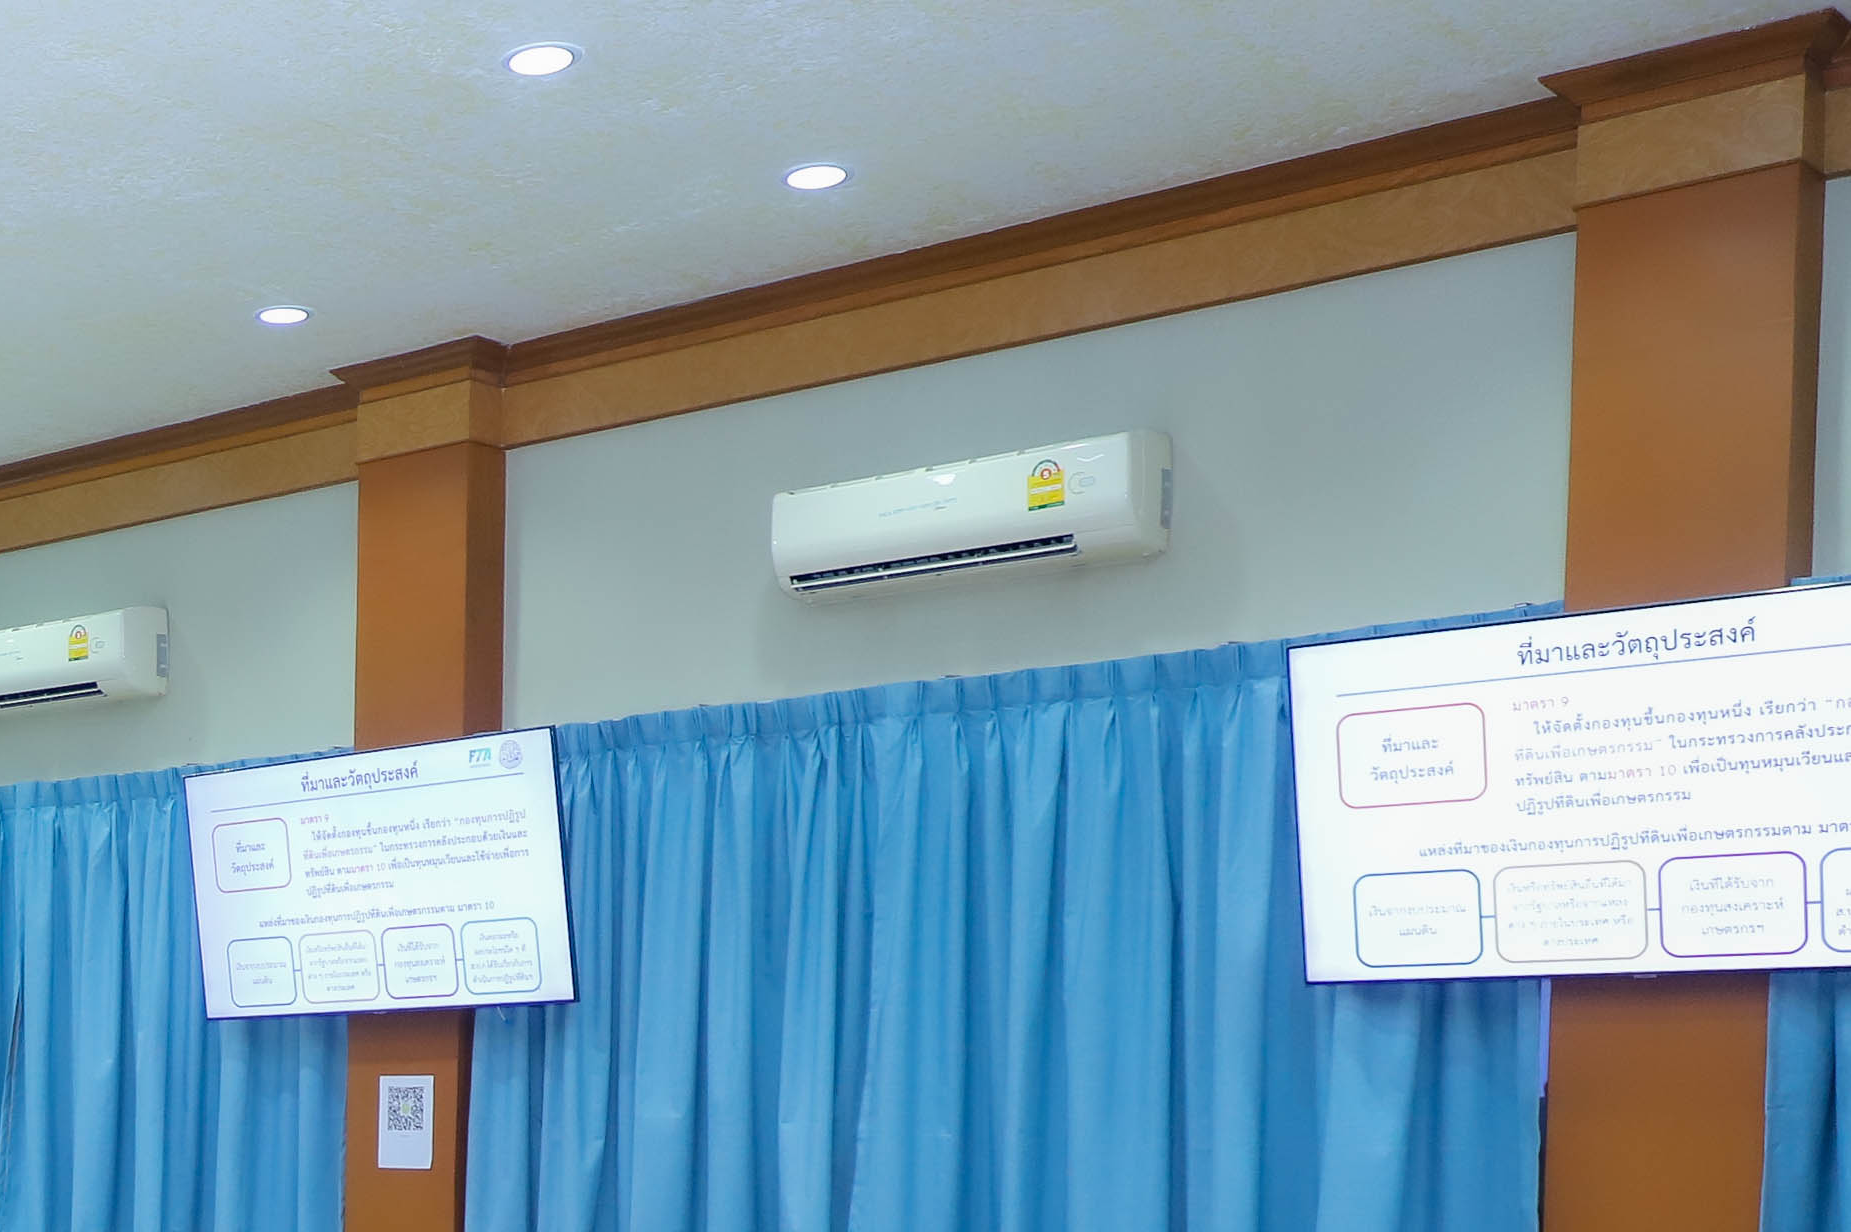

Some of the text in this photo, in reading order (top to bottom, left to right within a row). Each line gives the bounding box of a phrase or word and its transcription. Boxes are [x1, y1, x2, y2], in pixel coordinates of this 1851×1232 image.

[1517, 616, 1757, 667] ที่มาและวัตถุประสงค์
[1512, 696, 1570, 712] มาตรา 9
[1759, 697, 1817, 718] เรียกว่า
[1381, 734, 1438, 753] ที่มาและ
[301, 760, 419, 793] ที่มาและวัตถุประสงค์
[1370, 760, 1454, 784] วัตถุประสงค์
[1659, 763, 1677, 778] 10
